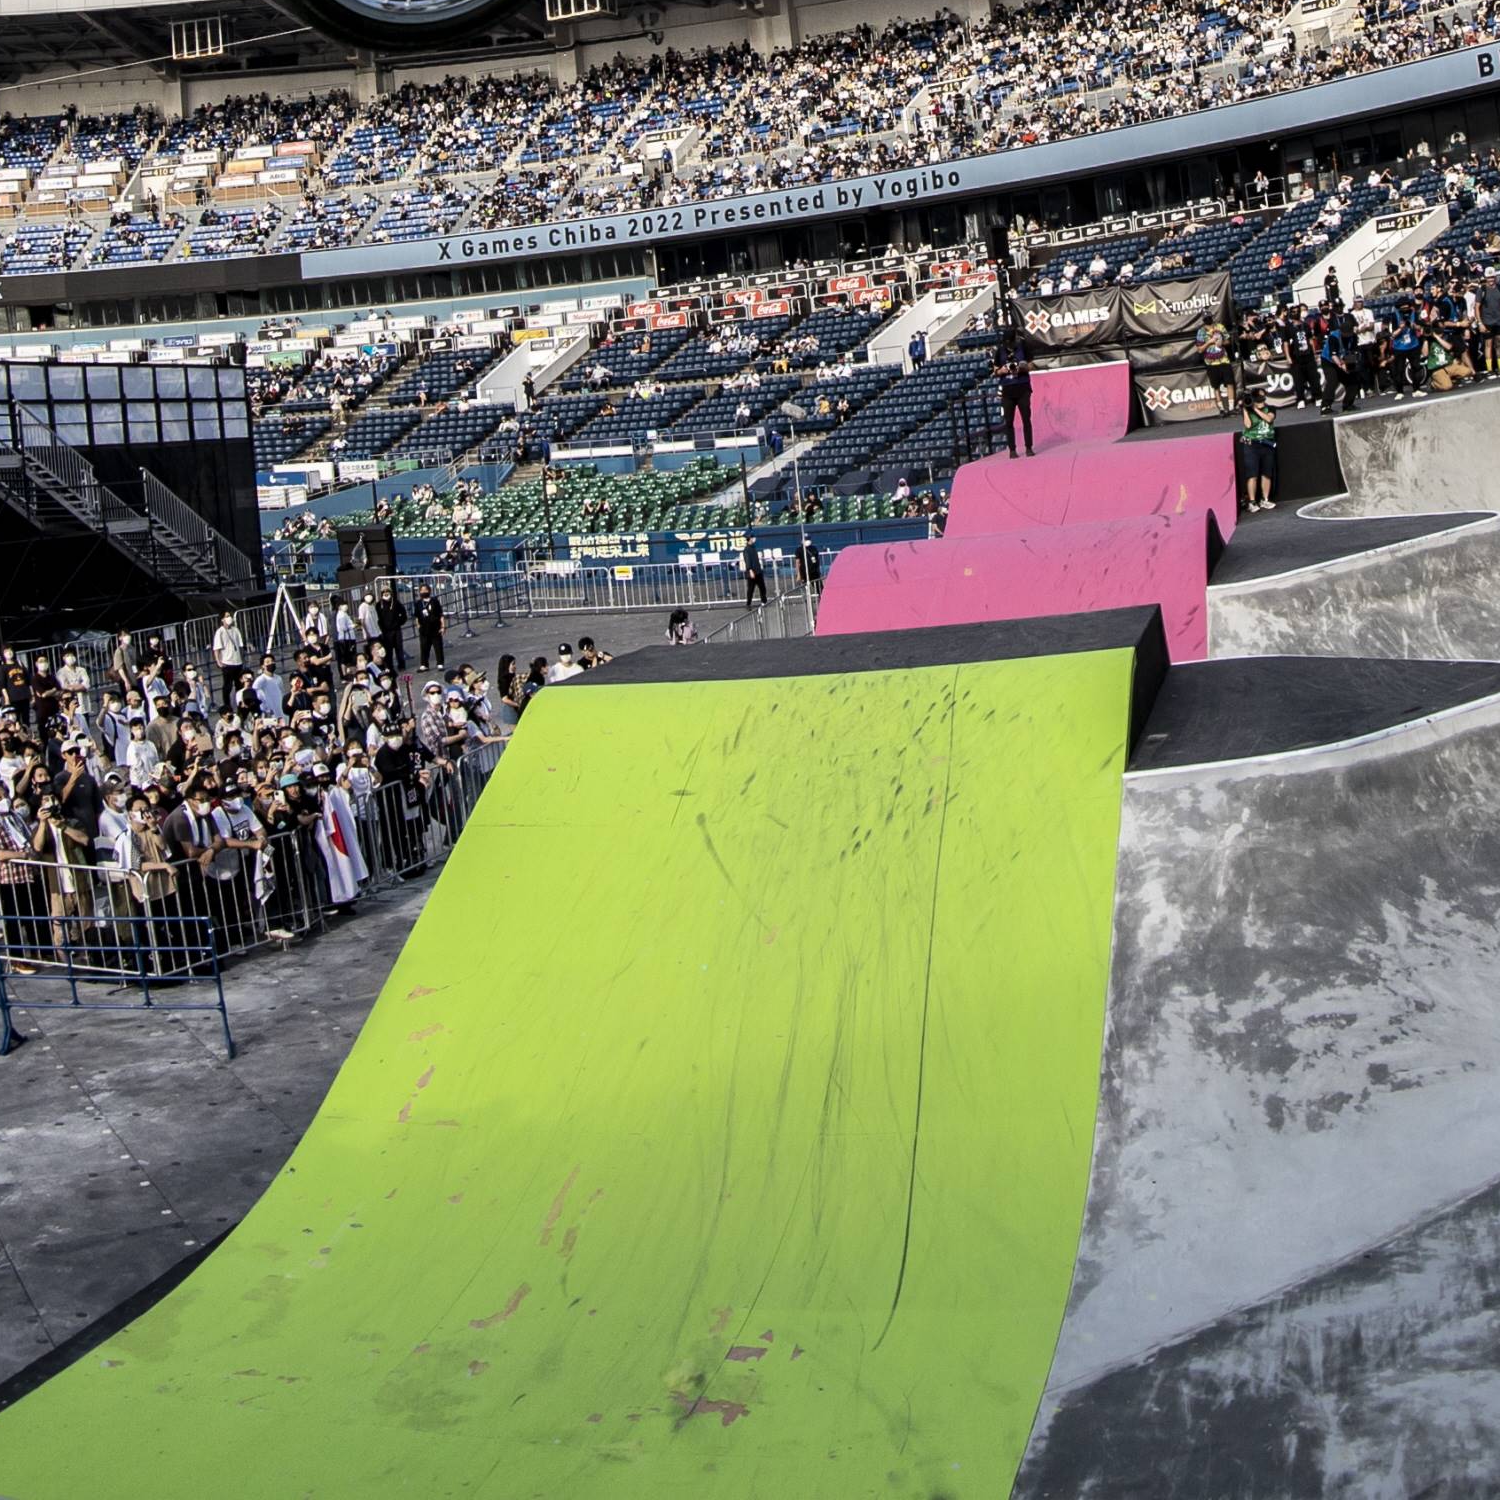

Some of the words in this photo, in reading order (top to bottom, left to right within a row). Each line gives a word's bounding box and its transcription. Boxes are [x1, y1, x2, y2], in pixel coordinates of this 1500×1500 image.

[438, 242, 452, 261] X
[461, 235, 538, 258] Games
[549, 223, 617, 248] Chiba
[627, 213, 684, 238] 2022
[694, 192, 826, 229] Presented
[836, 184, 865, 208] by
[873, 168, 961, 202] Yogibo
[1396, 214, 1420, 229] 213
[953, 288, 974, 300] 212
[1158, 294, 1221, 314] X-mobile
[1050, 306, 1110, 328] GAMES
[1067, 323, 1096, 335] CHIBA
